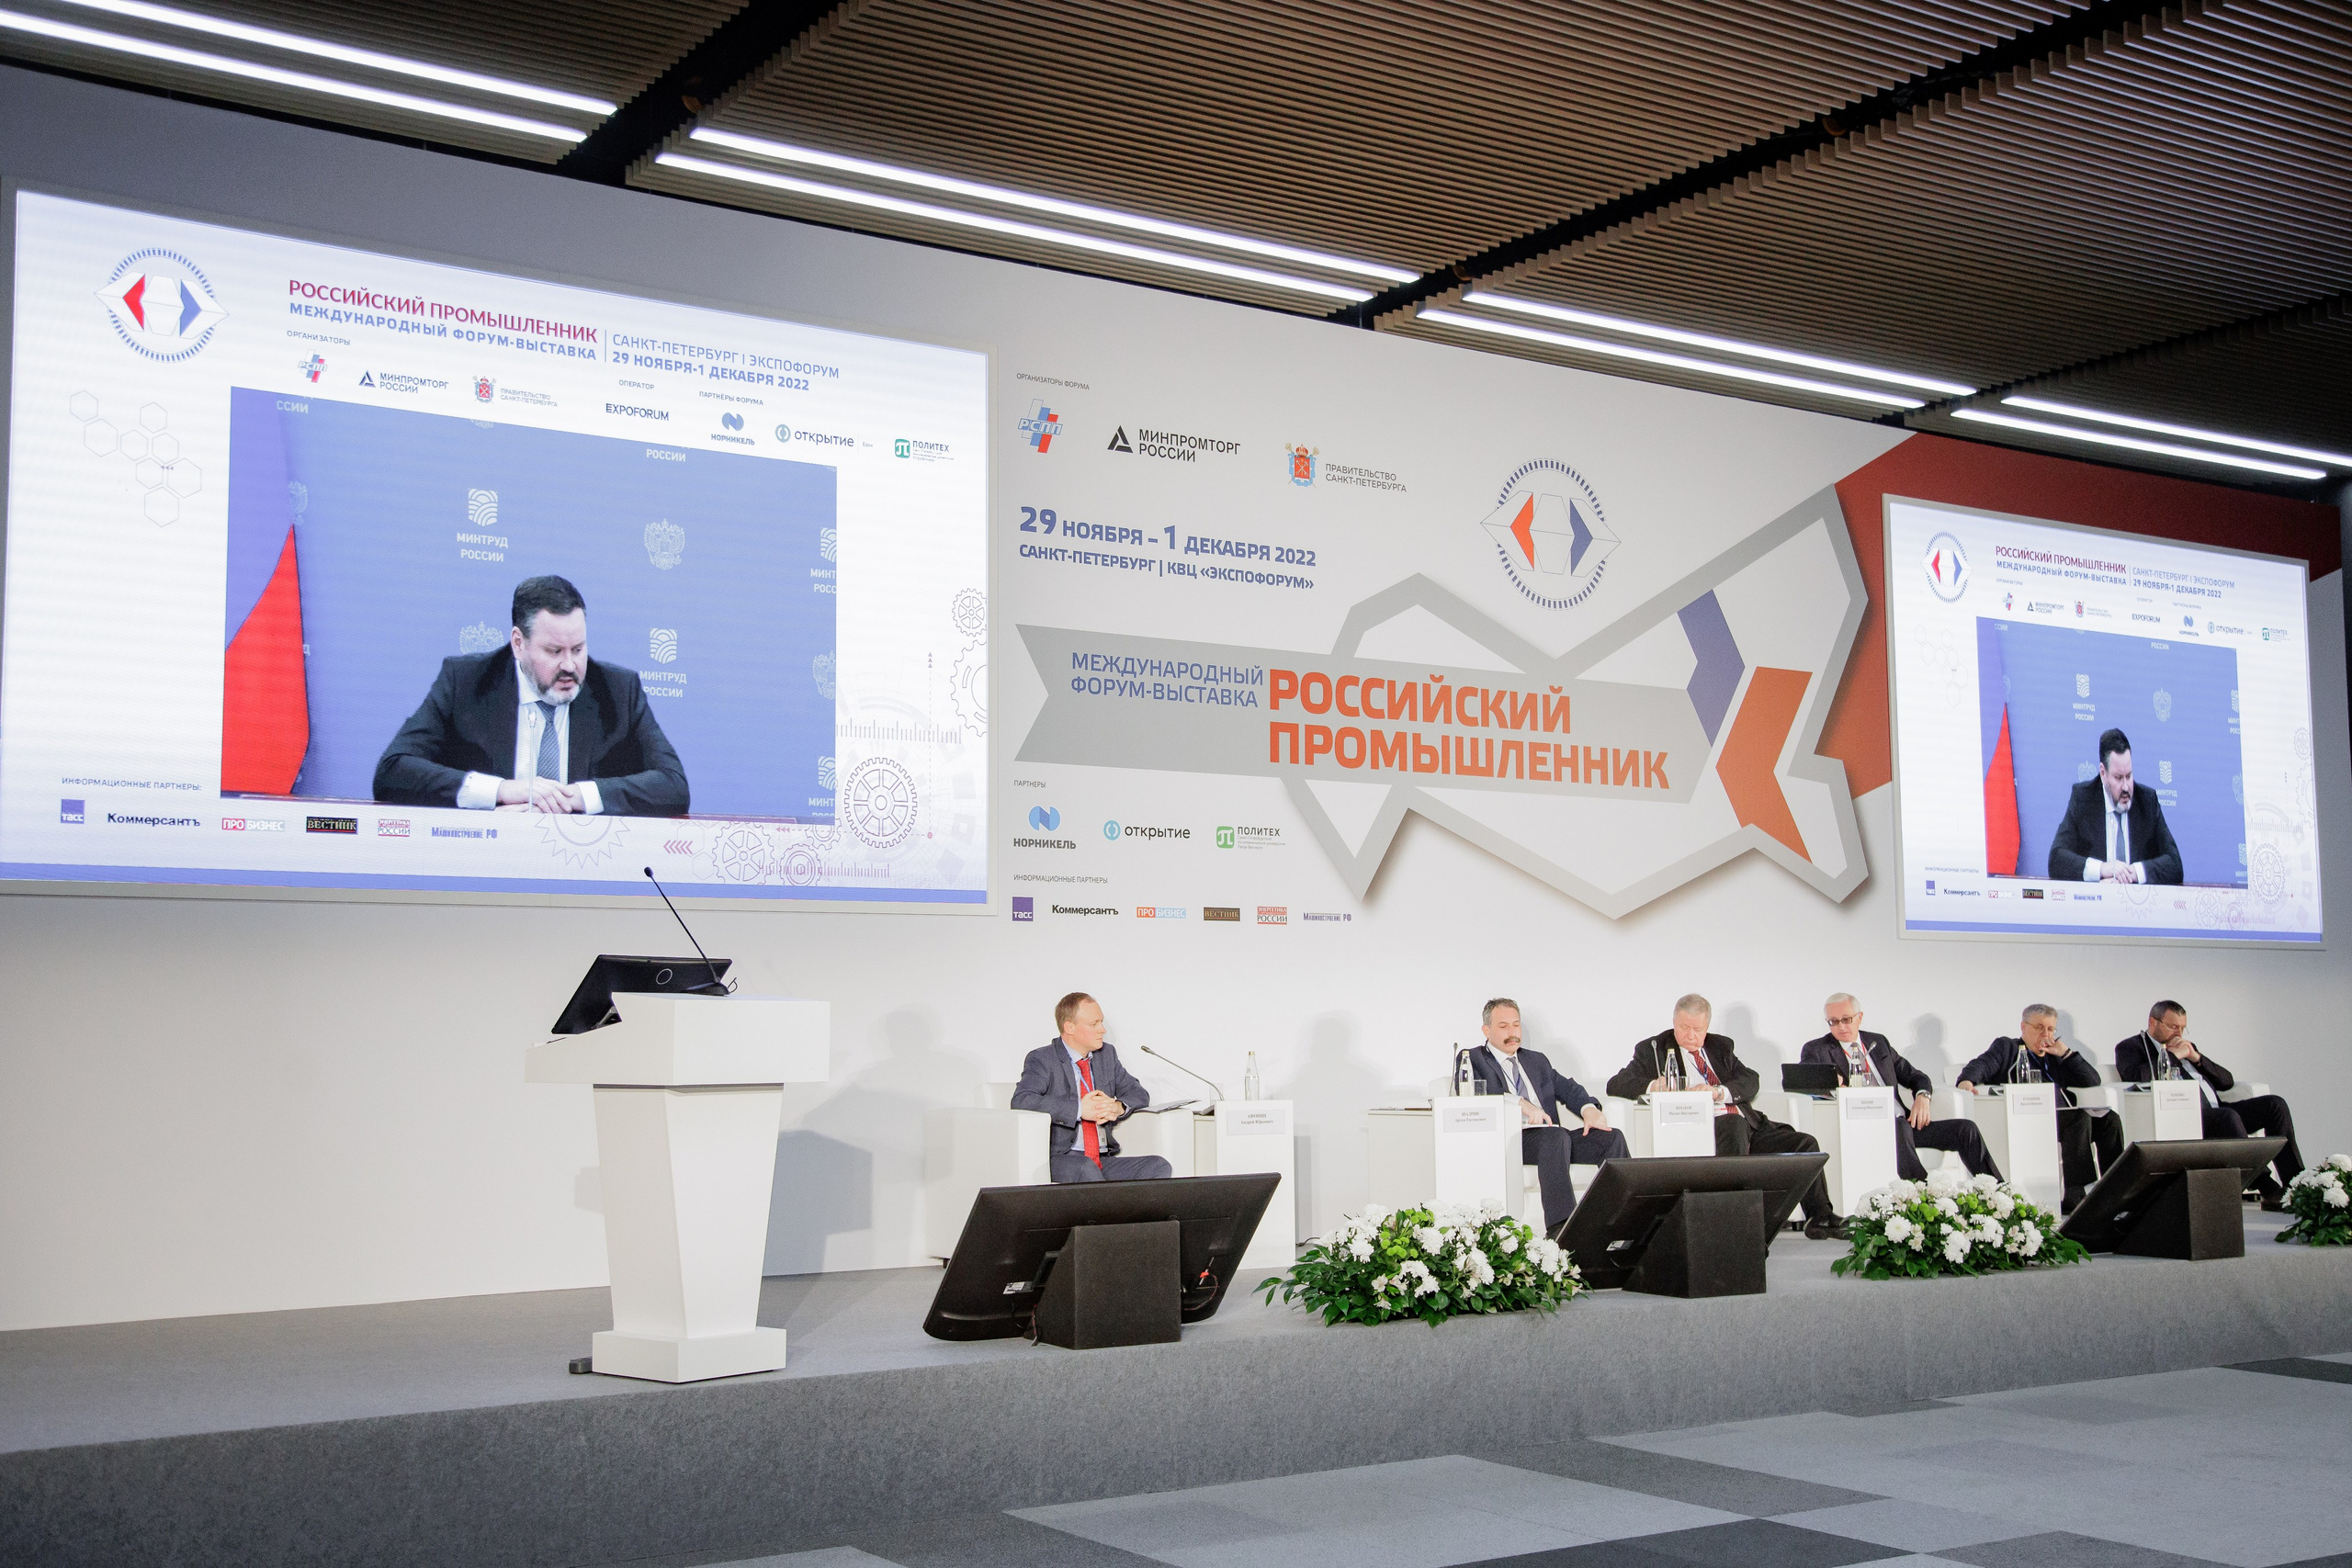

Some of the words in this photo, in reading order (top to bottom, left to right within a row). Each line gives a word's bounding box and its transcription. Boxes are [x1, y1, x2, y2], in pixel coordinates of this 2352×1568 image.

[289, 279, 424, 316] РОССИЙСКИЙ
[431, 302, 598, 344] ПРОМЫШЛЕННИК
[287, 330, 351, 346] ОРГАНИЗАТОРЫ
[289, 302, 447, 338] МЕЖДУНАРОДНЫЙ
[453, 328, 596, 360] ФОРУМ-ВЫСТАВКА
[613, 333, 739, 365] САНКТ-ПЕТЕРБУРГ
[749, 355, 840, 379] ЭКСПОФОРУМ
[299, 361, 328, 372] РСПП
[612, 351, 629, 365] 29
[634, 353, 705, 377] НОЯБРЯ-1
[708, 366, 774, 387] ДЕКАБРЯ
[777, 376, 809, 391] 2022
[379, 372, 449, 389] МИНПРОМТОРГ
[379, 382, 419, 394] РОССИИ
[618, 379, 654, 390] ОПЕРАТОР
[1016, 372, 1063, 386] ОРГАНИЗАТОРЫ
[1064, 380, 1090, 390] ФОРУМА
[500, 389, 551, 400] ПРАВИТЕЛЬСТВО
[500, 394, 558, 407] САНКТ-ПЕТЕРБУРГА
[736, 396, 763, 406] ФОРУМА
[605, 402, 669, 422] EXPOFORUM
[1019, 419, 1062, 434] РСПП
[711, 434, 755, 446] НОРНИКЕЛЬ
[794, 430, 854, 447] открытие
[1139, 428, 1241, 456] МИНПРОМТОРГ
[912, 440, 950, 453] ПОЛИТЕХ
[1139, 443, 1195, 462] РОССИИ
[646, 448, 686, 463] РОССИИ
[1326, 463, 1396, 481] ПРАВИТЕЛЬСТВО
[1326, 473, 1407, 492] САНКТ-ПЕТЕРБУРГА
[457, 532, 508, 548] МИНТРУД
[1020, 506, 1057, 535] 29
[1062, 520, 1143, 546] НОЯБРЯ
[1163, 525, 1176, 549] 1
[1184, 536, 1271, 561] ДЕКАБРЯ
[1274, 547, 1317, 567] 2022
[460, 549, 504, 563] РОССИИ
[1996, 546, 2052, 563] РОССИЙСКИЙ
[2053, 554, 2127, 574] ПРОМЫШЛЕННИК
[1019, 544, 1156, 571] САНКТ-ПЕТЕРБУРГ
[1167, 561, 1197, 580] КВЦ
[1200, 566, 1315, 589] «ЭКСПОФОРУМ»
[1996, 560, 2062, 577] МЕЖДУНАРОДНЫЙ
[2064, 570, 2127, 585] ФОРУМ-ВЫСТАВКА
[2132, 567, 2188, 582] САНКТ-ПЕТЕРБУРГ
[2193, 576, 2235, 590] ЭКСПОФОРУМ
[2133, 579, 2142, 587] 29
[2143, 580, 2175, 592] НОЯБРЯ-1
[2176, 585, 2206, 596] ДЕКАБРЯ
[2207, 590, 2222, 598] 2022
[2132, 613, 2161, 623] EXPOFORUM
[2215, 625, 2245, 636] открытие
[2151, 641, 2169, 650] РОССИИ
[1071, 652, 1263, 686] МЕЖДУНАРОДНЫЙ
[640, 670, 687, 685] МИНТРУД
[642, 686, 684, 698] РОССИИ
[1070, 676, 1259, 707] ФОРУМ-ВЫСТАВКА
[1269, 668, 1571, 735] РОССИЙСКИЙ
[2072, 702, 2096, 713] МИНТРУД
[2075, 713, 2094, 722] РОССИИ
[1269, 721, 1670, 790] ПРОМЫШЛЕННИК
[62, 777, 152, 789] ИНФОРМАЦИОННЫЕ
[1013, 779, 1046, 788] ПАРТНЕРЫ
[107, 812, 201, 827] Коммерсантъ
[223, 818, 244, 829] ПРО
[307, 819, 356, 830] ВЕСТНИК
[1124, 825, 1191, 840] открытие
[1237, 826, 1280, 837] ПОЛИТЕХ
[1013, 838, 1077, 850] НОРНИКЕЛЬ
[1013, 874, 1076, 883] ИНФОРМАЦИОННЫЕ
[1077, 876, 1108, 885] ПАРТНЕРЫ
[1943, 888, 1981, 897] Коммерсантъ
[1052, 904, 1119, 917] Коммерсантъ
[1137, 908, 1155, 917] ПРО
[1156, 908, 1185, 918] БИЗНЕС
[1204, 910, 1239, 919] ВЕСТНИК
[1342, 913, 1352, 922] РФ
